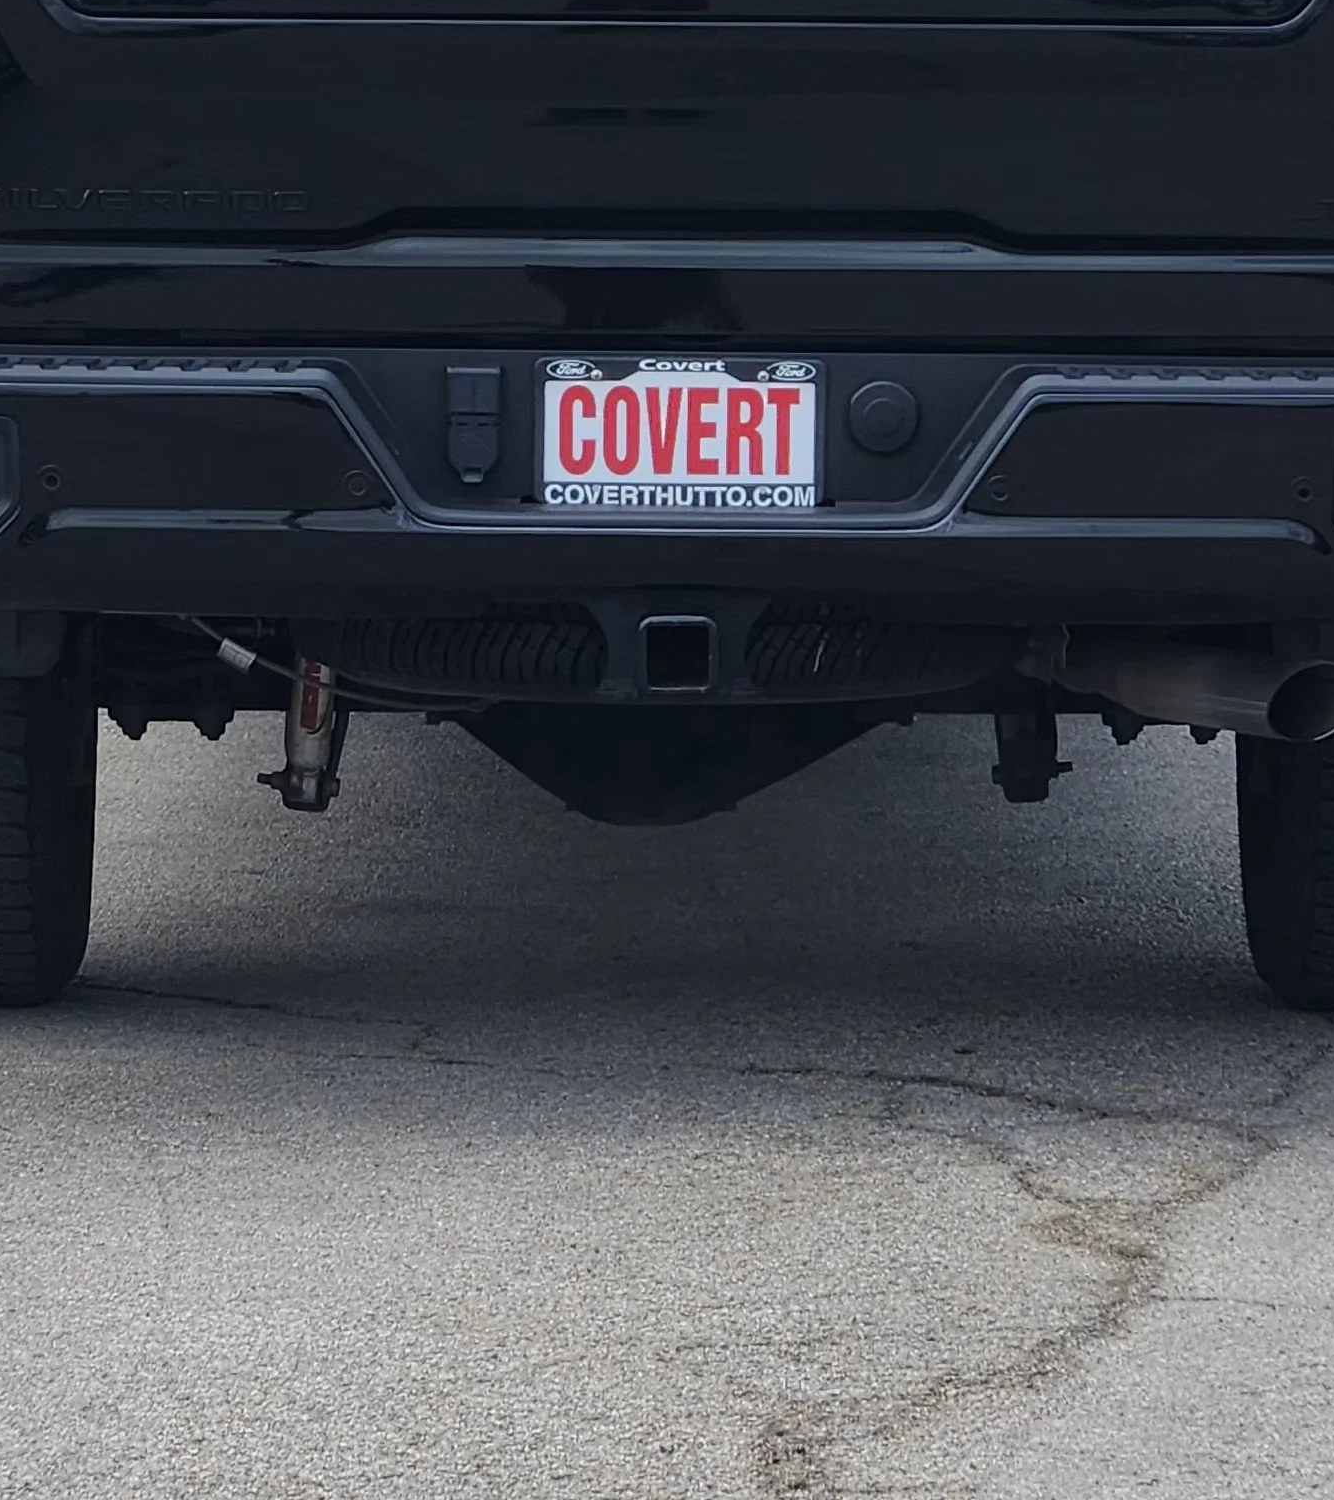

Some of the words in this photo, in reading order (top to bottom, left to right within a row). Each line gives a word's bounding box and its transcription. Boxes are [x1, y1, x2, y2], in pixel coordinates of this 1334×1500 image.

[638, 358, 726, 372] Covert
[559, 384, 801, 476] COVERT
[544, 484, 816, 508] COVERTHUTTO.COM
